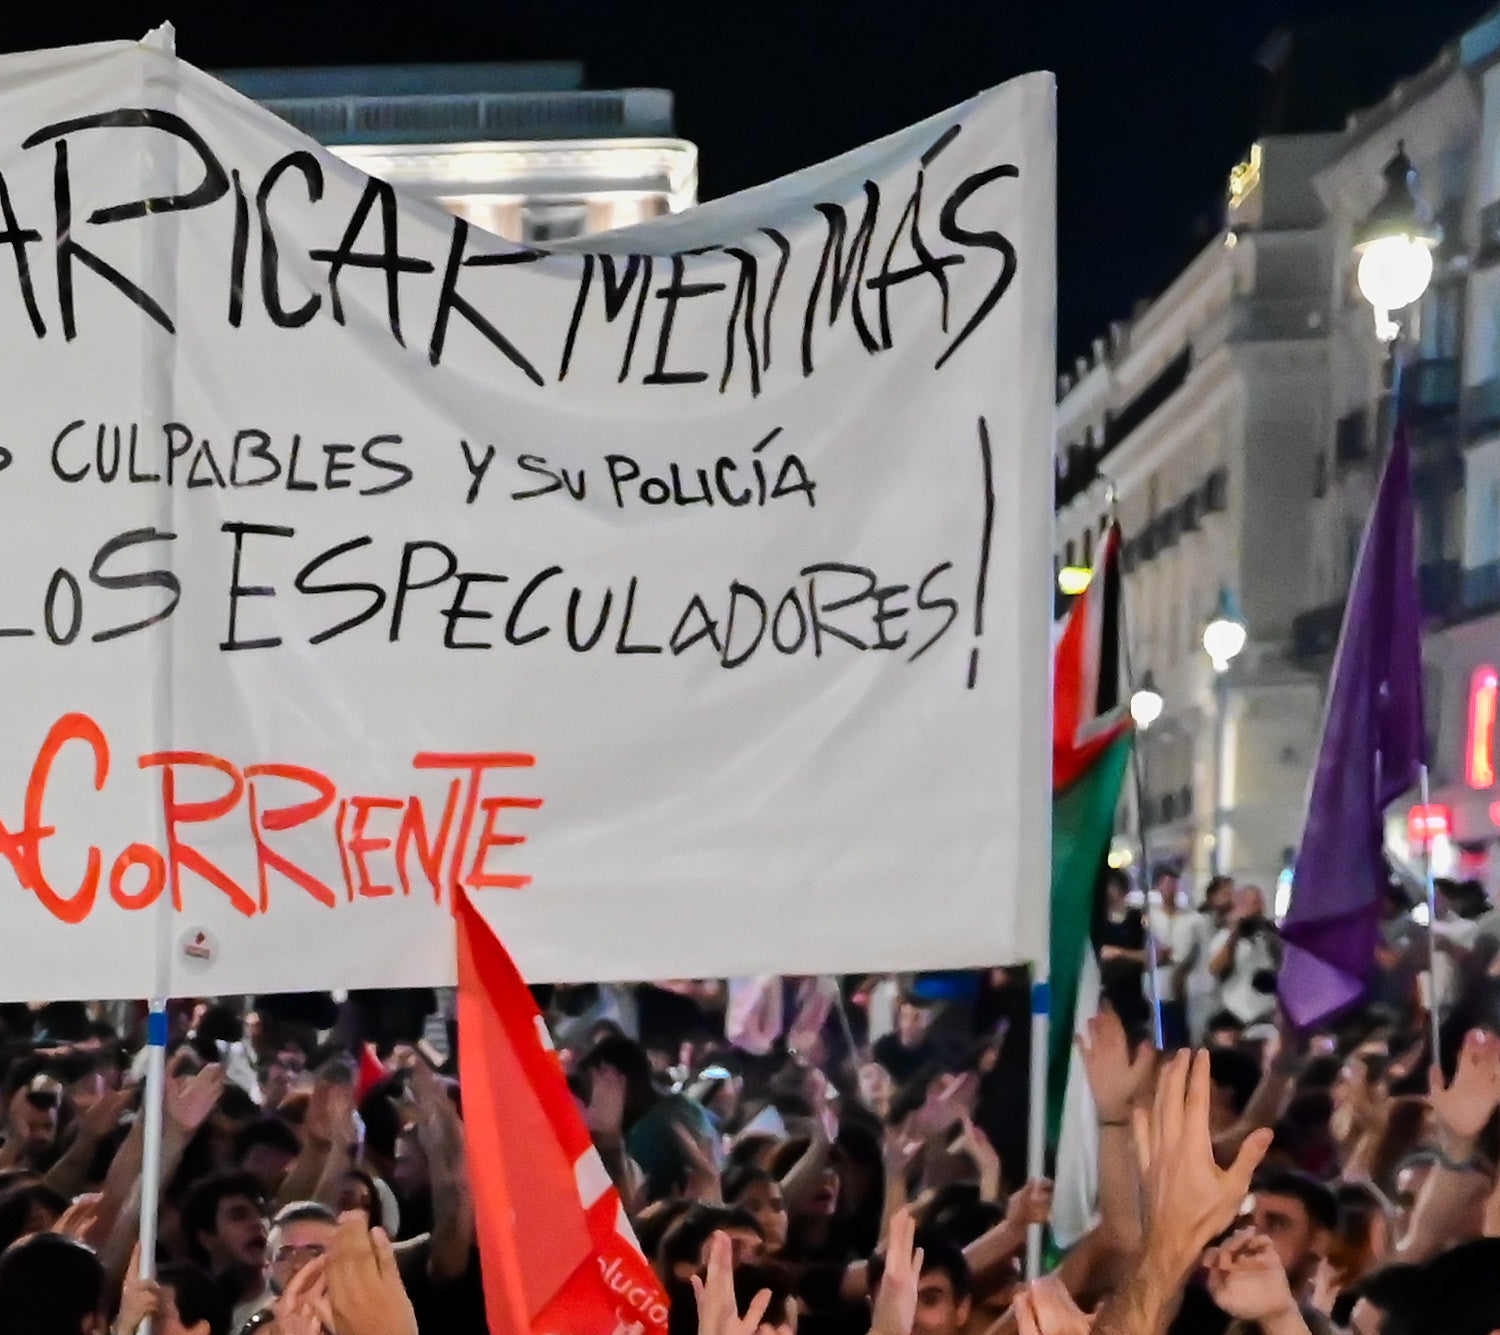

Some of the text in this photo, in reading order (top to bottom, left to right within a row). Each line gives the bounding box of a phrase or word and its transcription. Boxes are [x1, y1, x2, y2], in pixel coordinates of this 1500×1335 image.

[800, 123, 1019, 378] MÁS
[51, 420, 413, 496] CULPABLES
[460, 440, 496, 504] Y
[610, 426, 817, 508] POLICÍA
